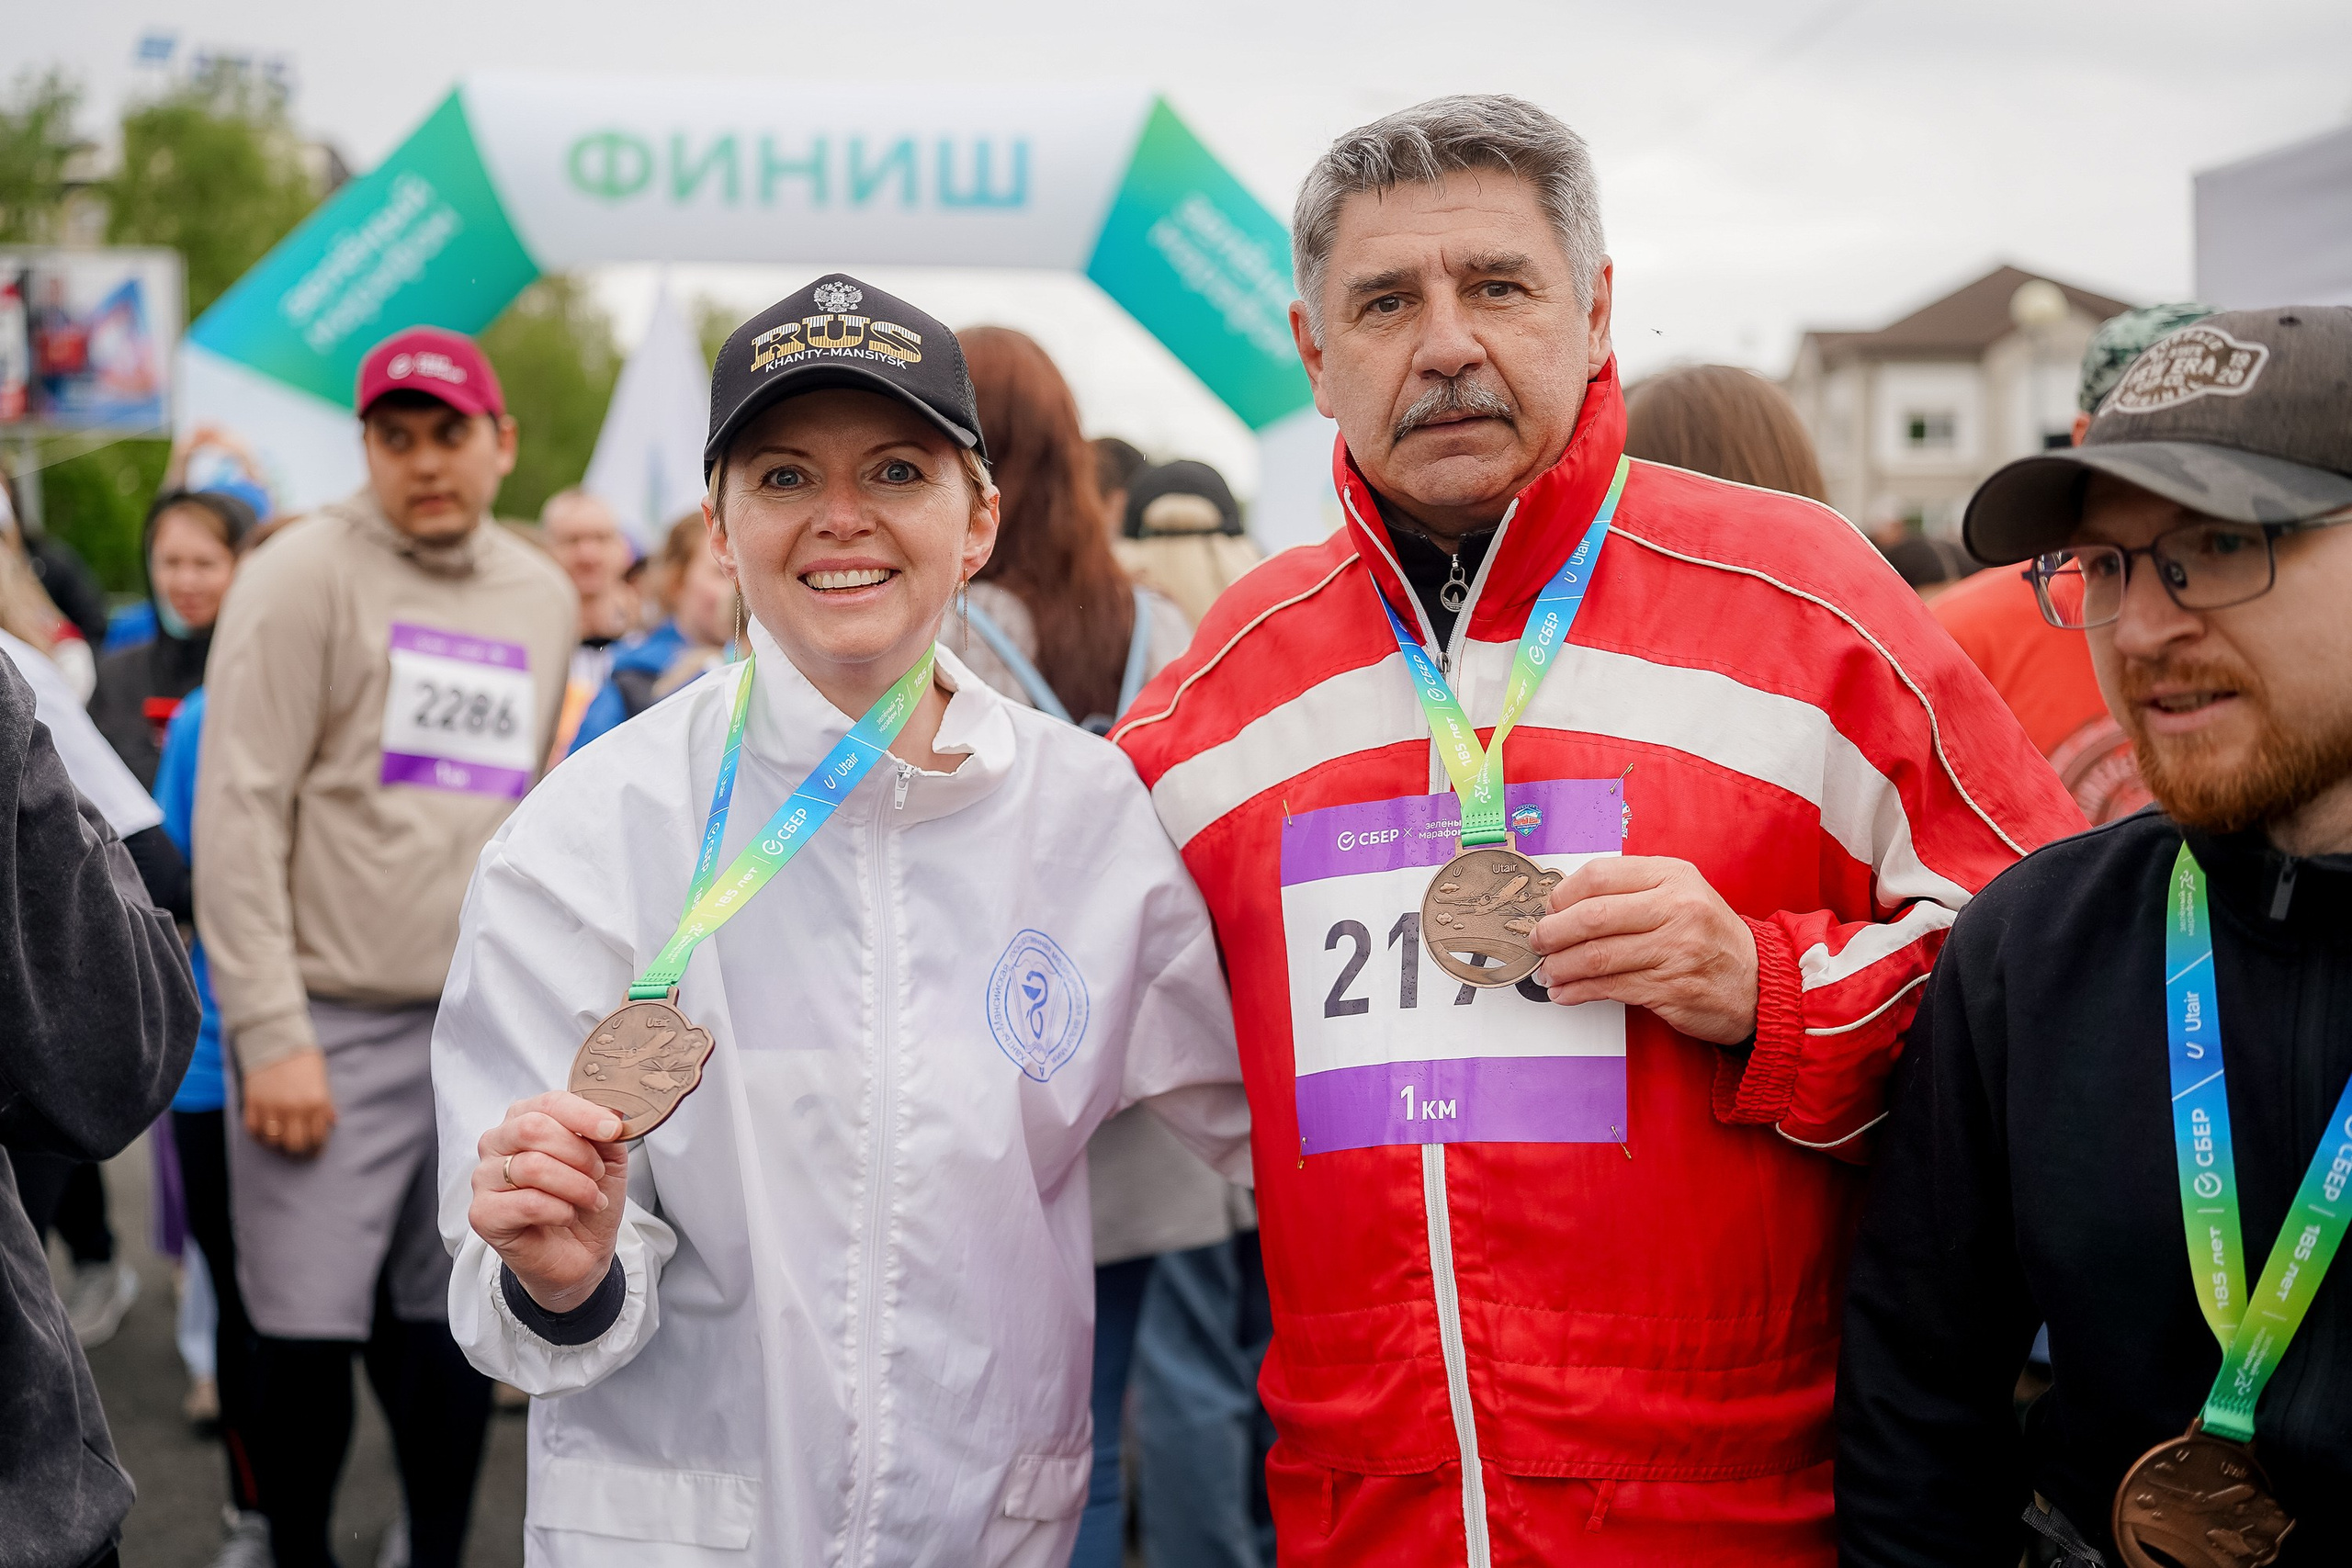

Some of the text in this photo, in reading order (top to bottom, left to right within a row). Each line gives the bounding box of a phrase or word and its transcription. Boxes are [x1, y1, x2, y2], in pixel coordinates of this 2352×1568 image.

[565, 130, 1032, 209] ФИНИШ
[751, 314, 922, 372] RUS
[765, 347, 907, 373] KHANTY-MANSIYSK
[2170, 355, 2217, 377] ERA
[1570, 537, 1591, 566] Utair
[1538, 612, 1559, 646] СБЕР
[1413, 654, 1437, 684] СБЕР
[413, 680, 517, 739] 2286
[1445, 716, 1473, 767] 185 лет
[834, 751, 859, 777] Utair
[777, 807, 808, 840] СБЕР
[1358, 829, 1399, 846] СБЕР
[1425, 818, 1462, 830] зелёны
[701, 840, 715, 873] СБЕР
[1492, 863, 1517, 874] Utair
[715, 866, 758, 908] 185 лет
[646, 1016, 671, 1028] Utair
[992, 964, 1026, 1064] Ханты-Мансийская
[2184, 990, 2201, 1032] Utair
[1400, 1085, 1415, 1121] 1
[2191, 1108, 2214, 1167] СБЕР
[2210, 1226, 2229, 1309] 185 лет
[2277, 1224, 2322, 1303] 185 лет
